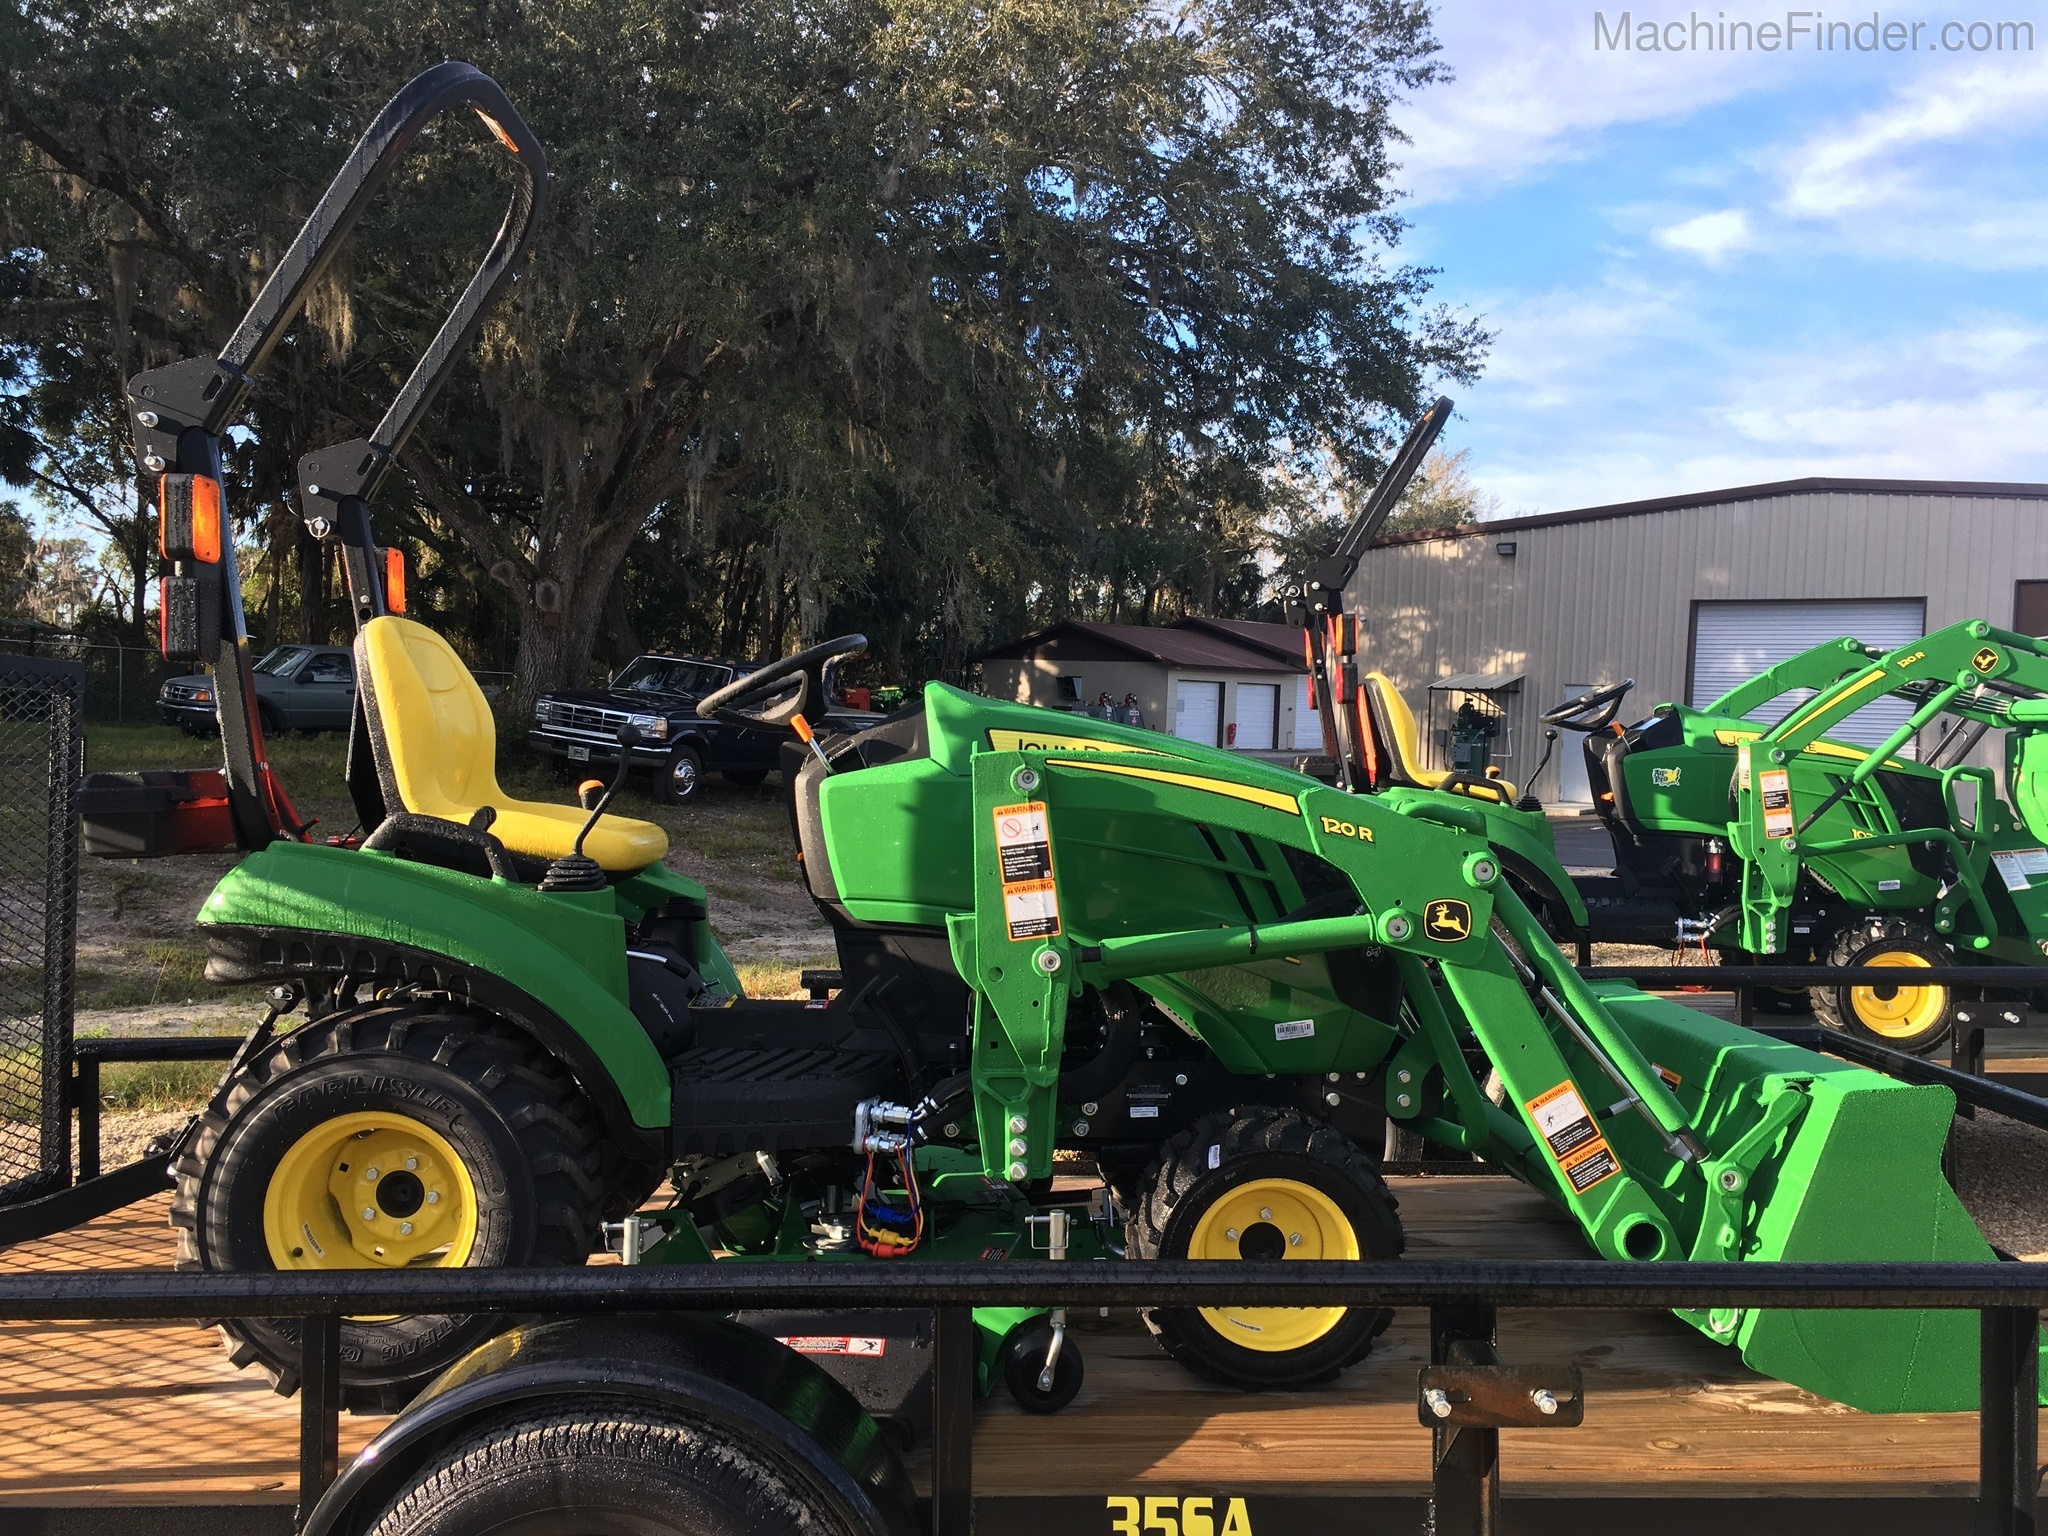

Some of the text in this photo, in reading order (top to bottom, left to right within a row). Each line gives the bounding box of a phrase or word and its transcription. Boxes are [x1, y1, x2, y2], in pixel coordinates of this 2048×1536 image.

[1003, 804, 1043, 814] WARNING
[1013, 882, 1053, 893] WARNING
[273, 1076, 459, 1122] CARLISLE
[1539, 1085, 1568, 1105] WARNING
[1573, 1143, 1602, 1163] WARNING
